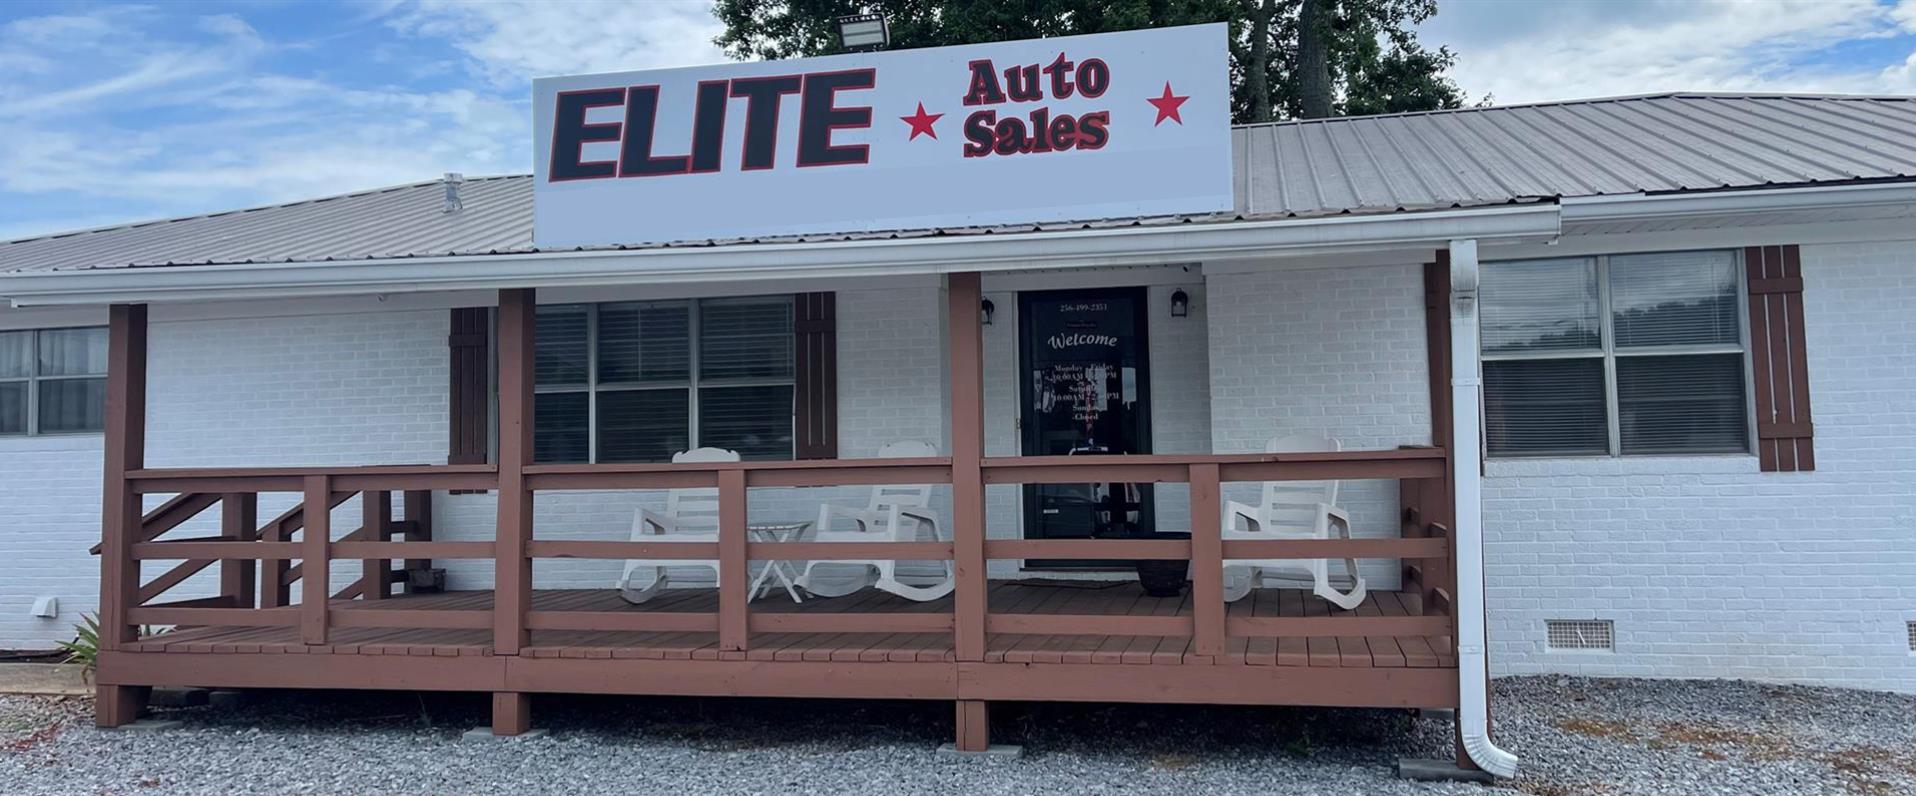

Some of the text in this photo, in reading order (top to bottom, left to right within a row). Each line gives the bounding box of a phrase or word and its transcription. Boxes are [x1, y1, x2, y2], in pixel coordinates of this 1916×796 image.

[963, 51, 1110, 106] Auto
[548, 67, 877, 183] ELITE
[962, 106, 1111, 158] Sales
[1047, 332, 1118, 349] Welcome
[1054, 364, 1083, 372] Monday
